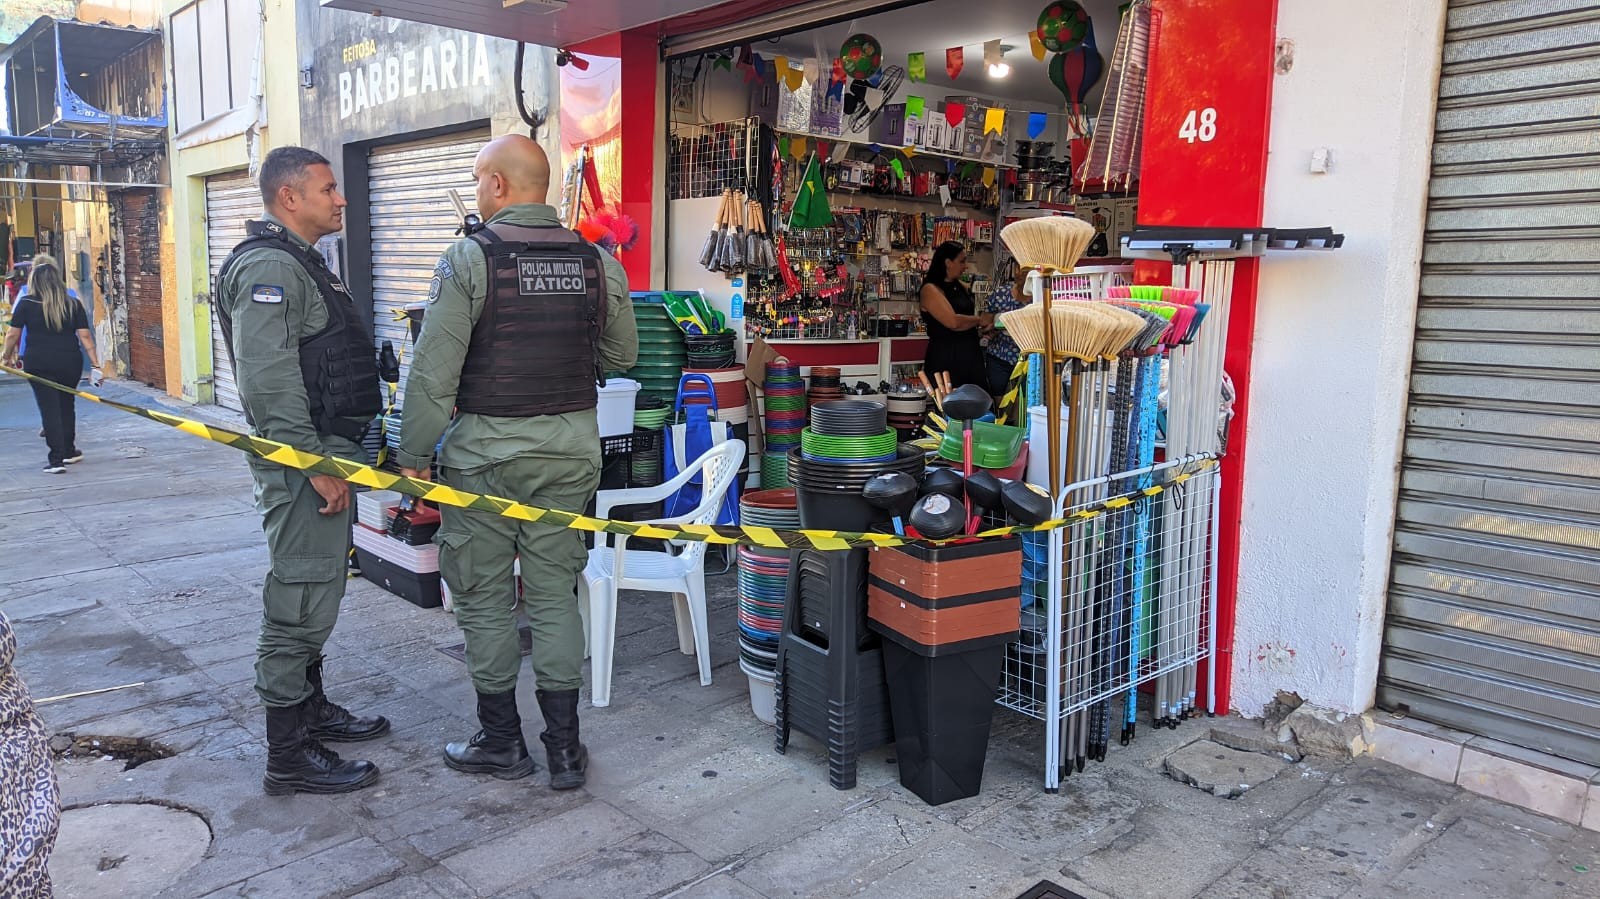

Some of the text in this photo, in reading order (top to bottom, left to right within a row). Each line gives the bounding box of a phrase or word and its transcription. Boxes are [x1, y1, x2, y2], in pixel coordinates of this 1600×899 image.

[343, 38, 377, 64] FEITOSA
[339, 34, 491, 120] BARBEARIA
[1178, 107, 1217, 144] 48
[521, 260, 580, 276] POLÍCIA MILITAR
[522, 275, 583, 291] TÁTICO
